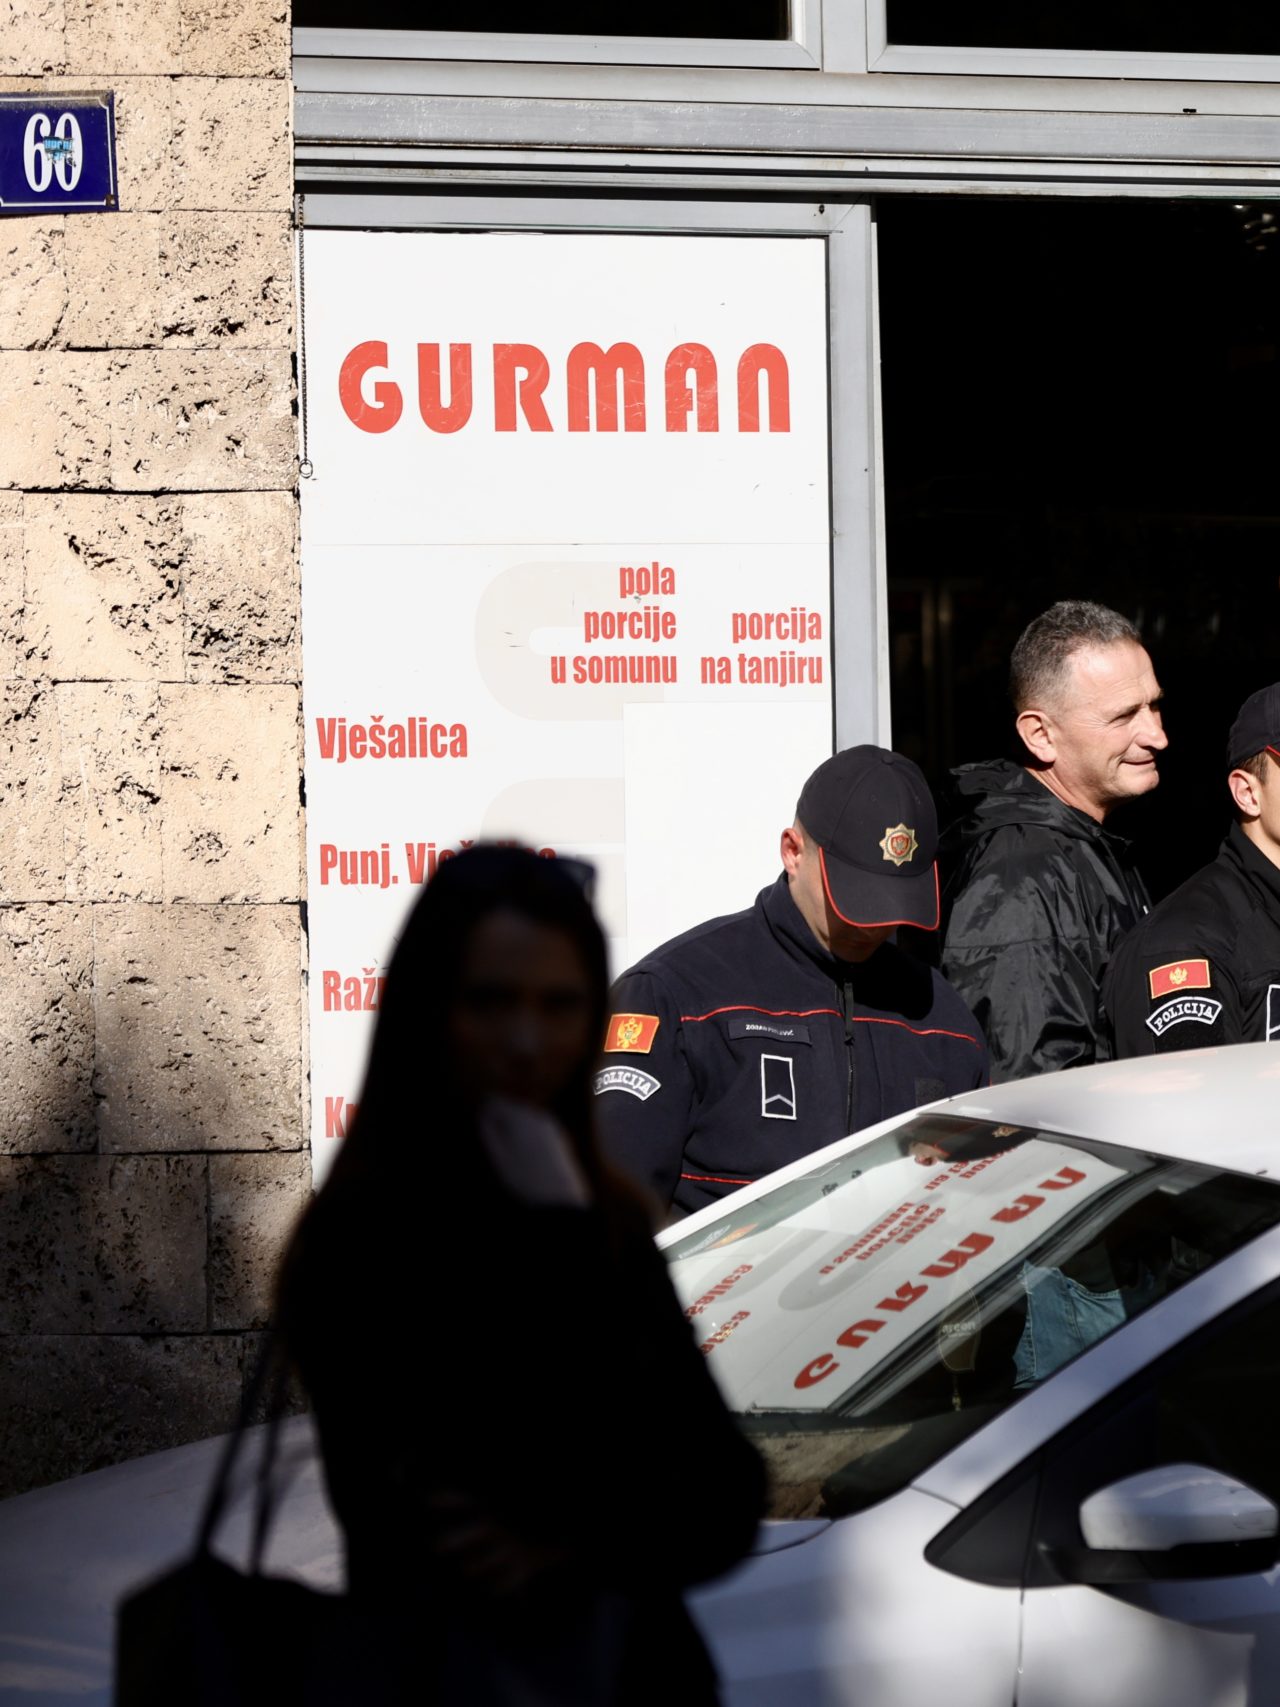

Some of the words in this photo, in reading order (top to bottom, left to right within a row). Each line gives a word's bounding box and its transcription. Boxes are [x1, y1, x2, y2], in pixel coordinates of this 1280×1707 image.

[23, 112, 83, 192] 60
[339, 341, 791, 434] GURMAN
[619, 562, 676, 596] pola
[584, 606, 677, 643] porcije
[732, 608, 823, 643] porcija
[551, 656, 567, 685] u
[573, 656, 678, 685] somunu
[701, 657, 732, 685] na
[738, 651, 823, 688] tanjiru
[316, 715, 469, 764] Vješalica
[320, 843, 399, 890] Punj.
[1154, 1003, 1213, 1030] POLICIJA
[596, 1071, 652, 1095] POLICIJA
